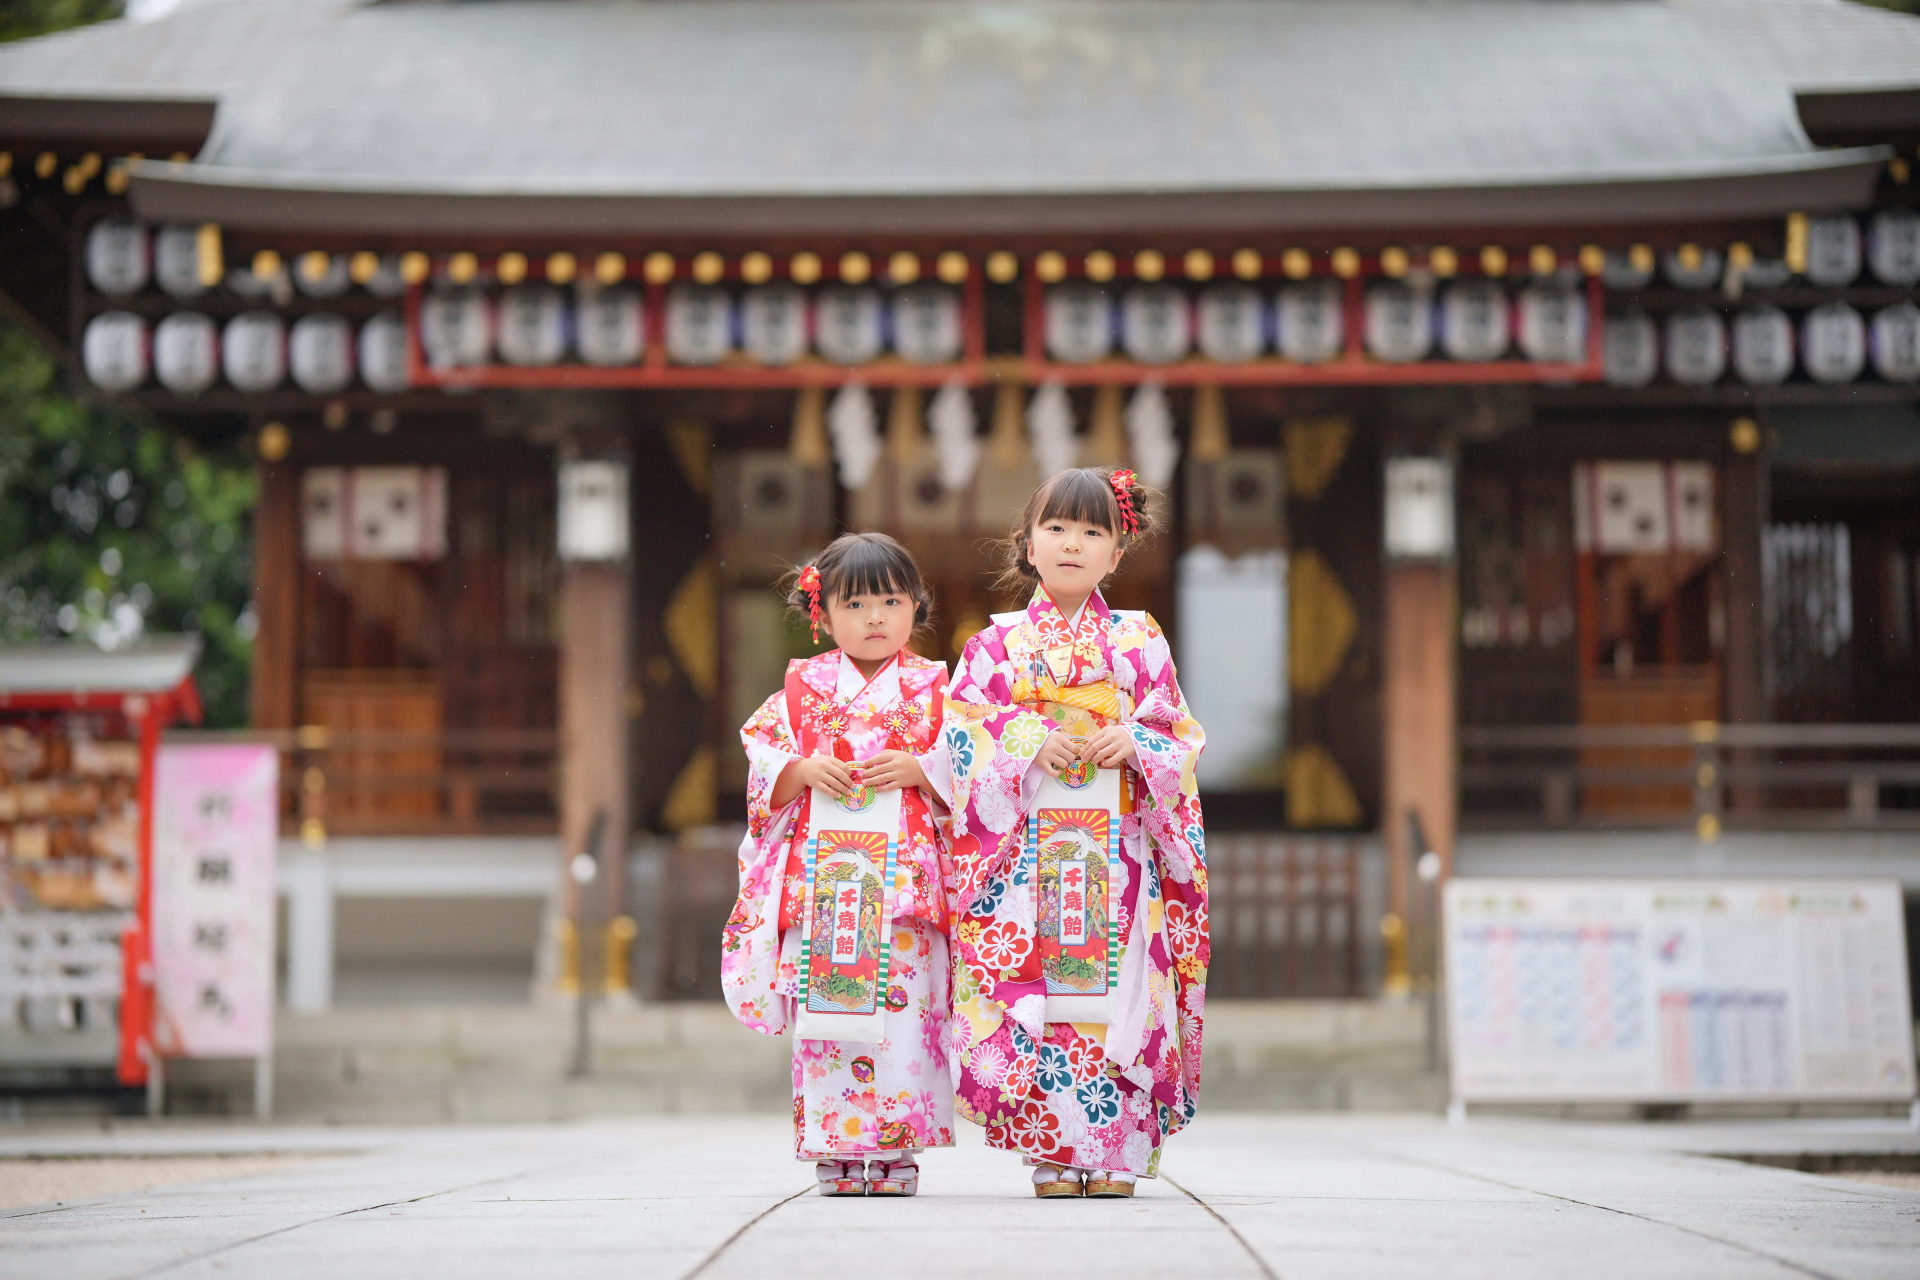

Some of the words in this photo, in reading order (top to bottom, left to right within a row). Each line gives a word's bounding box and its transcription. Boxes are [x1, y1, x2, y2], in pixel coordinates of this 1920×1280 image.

[836, 888, 858, 955] 千歳飴
[1063, 867, 1083, 937] 千歳飴
